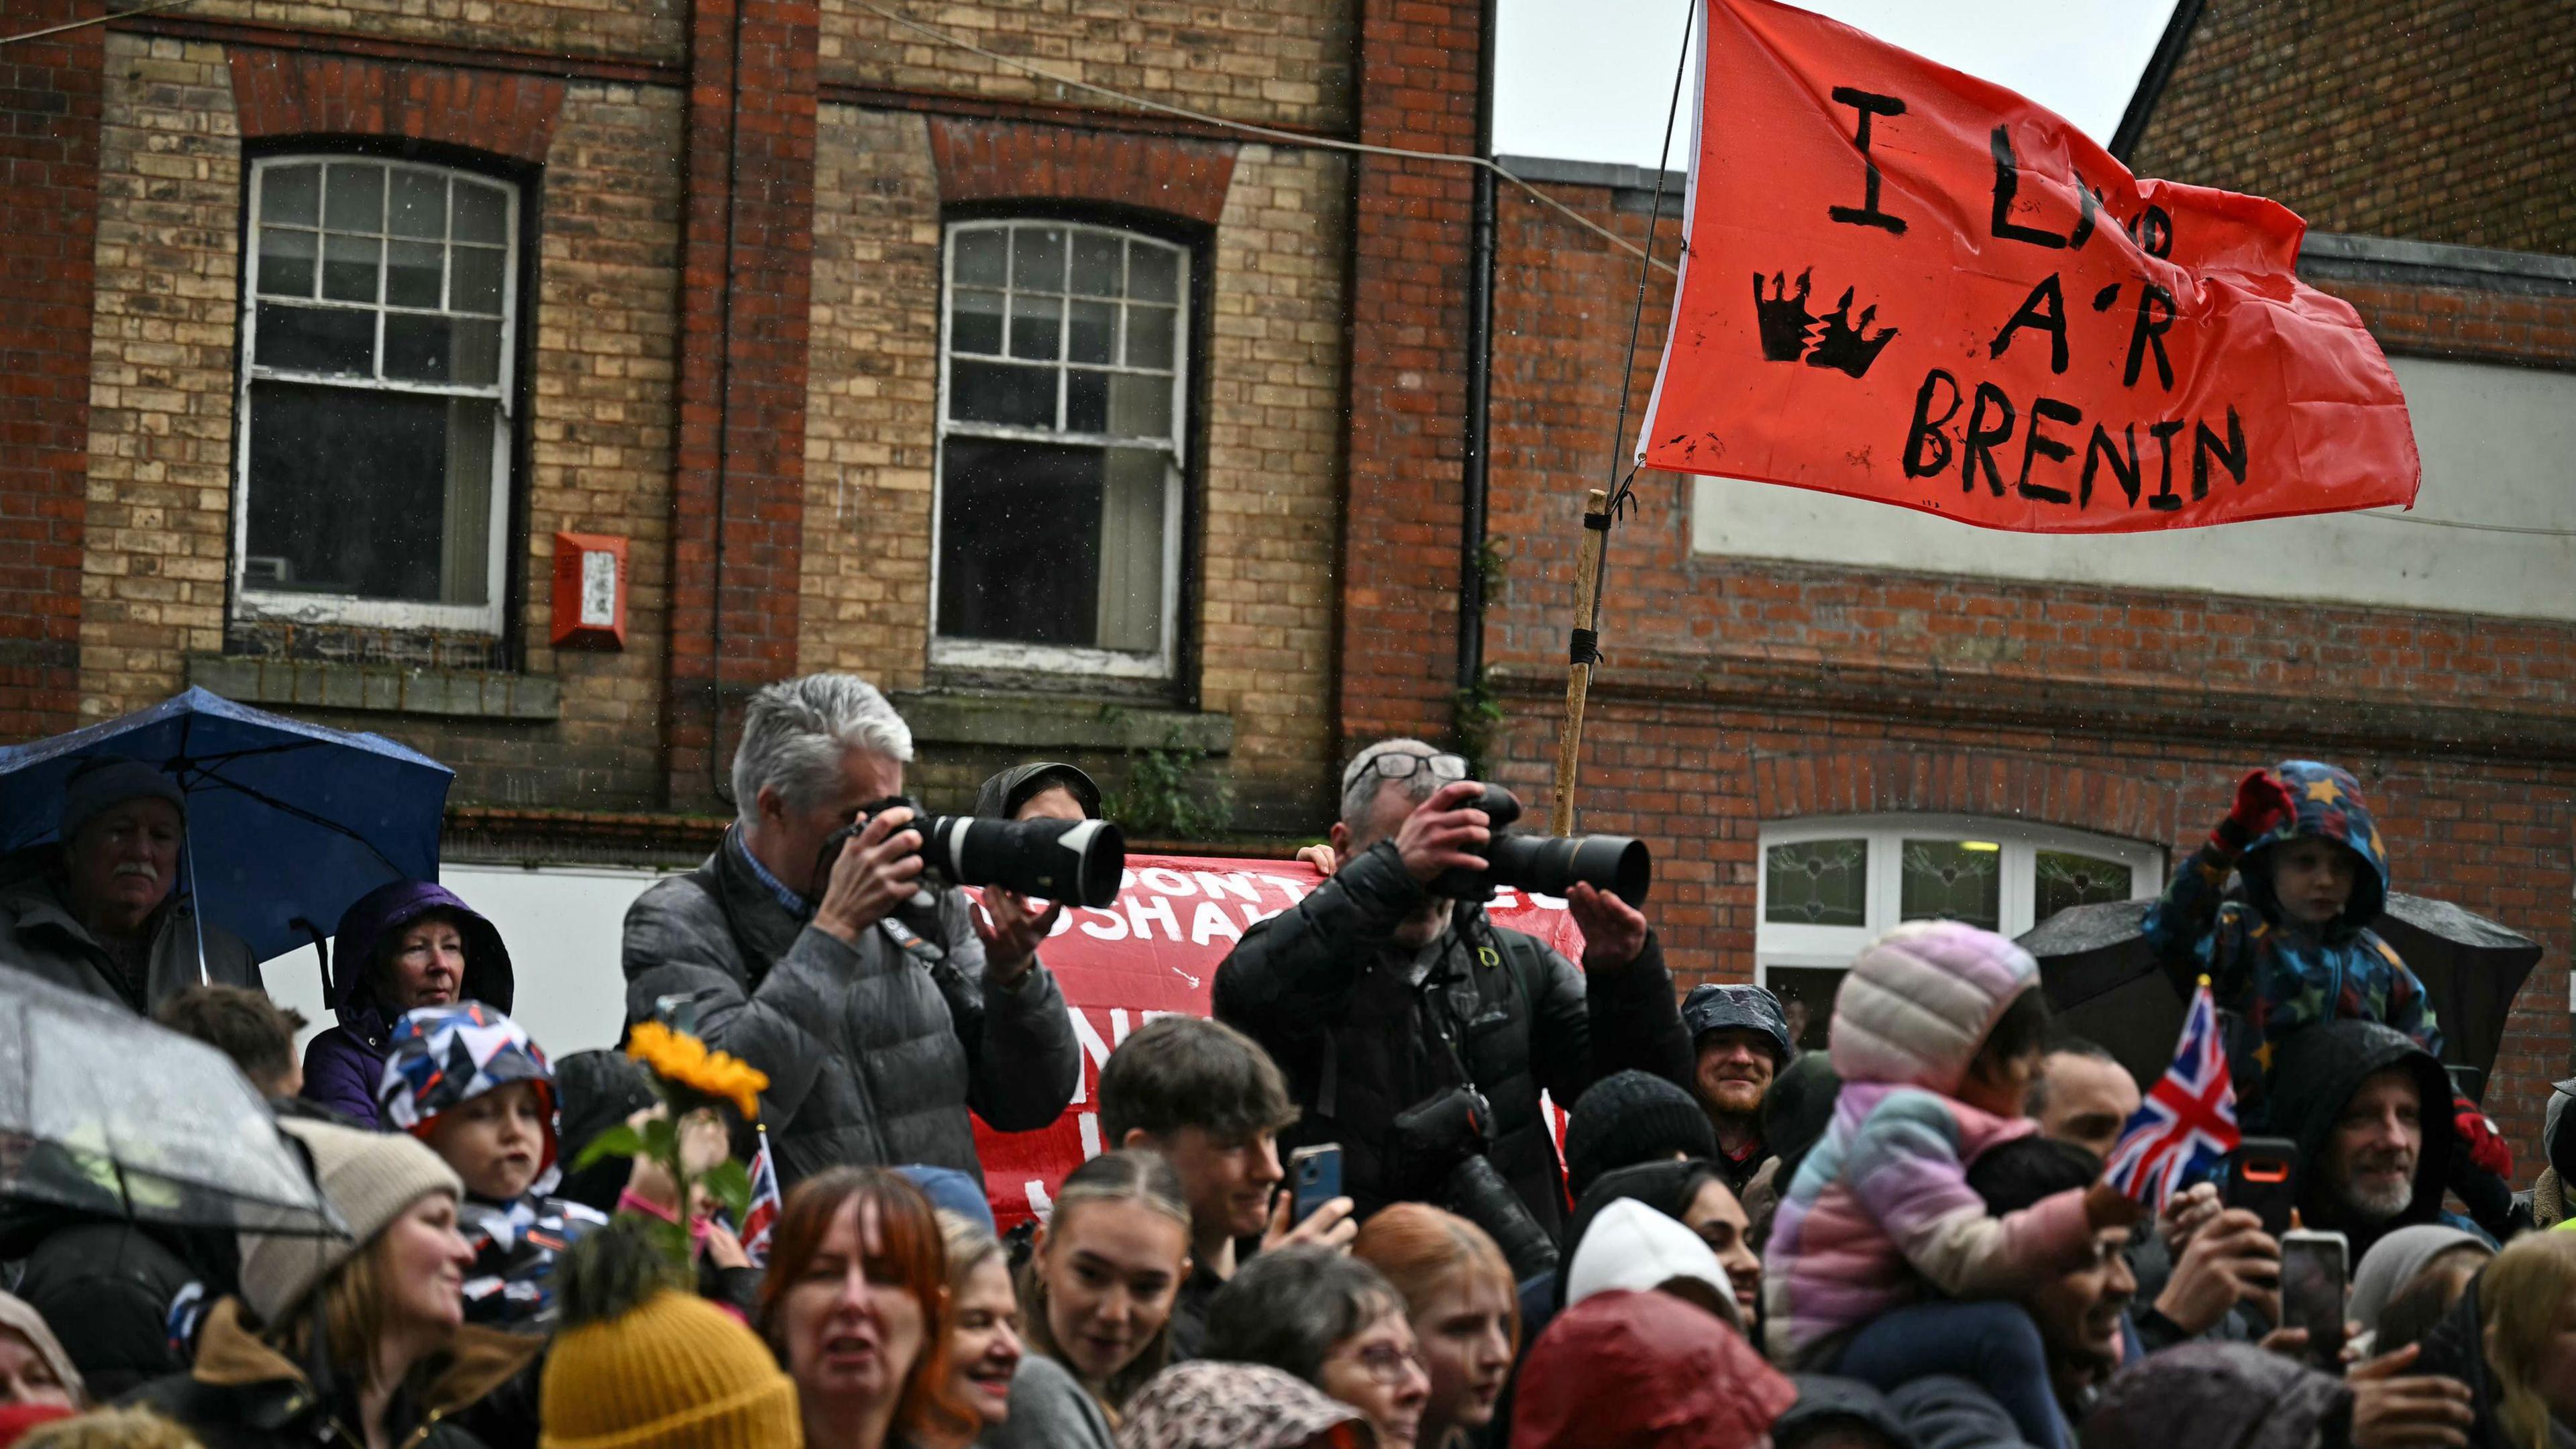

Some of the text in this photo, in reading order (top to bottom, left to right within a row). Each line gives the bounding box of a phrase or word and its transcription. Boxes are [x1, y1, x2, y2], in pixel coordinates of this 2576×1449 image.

[1828, 87, 1908, 235] I
[1989, 272, 2176, 393] A'R
[1903, 368, 2247, 511] BRENIN
